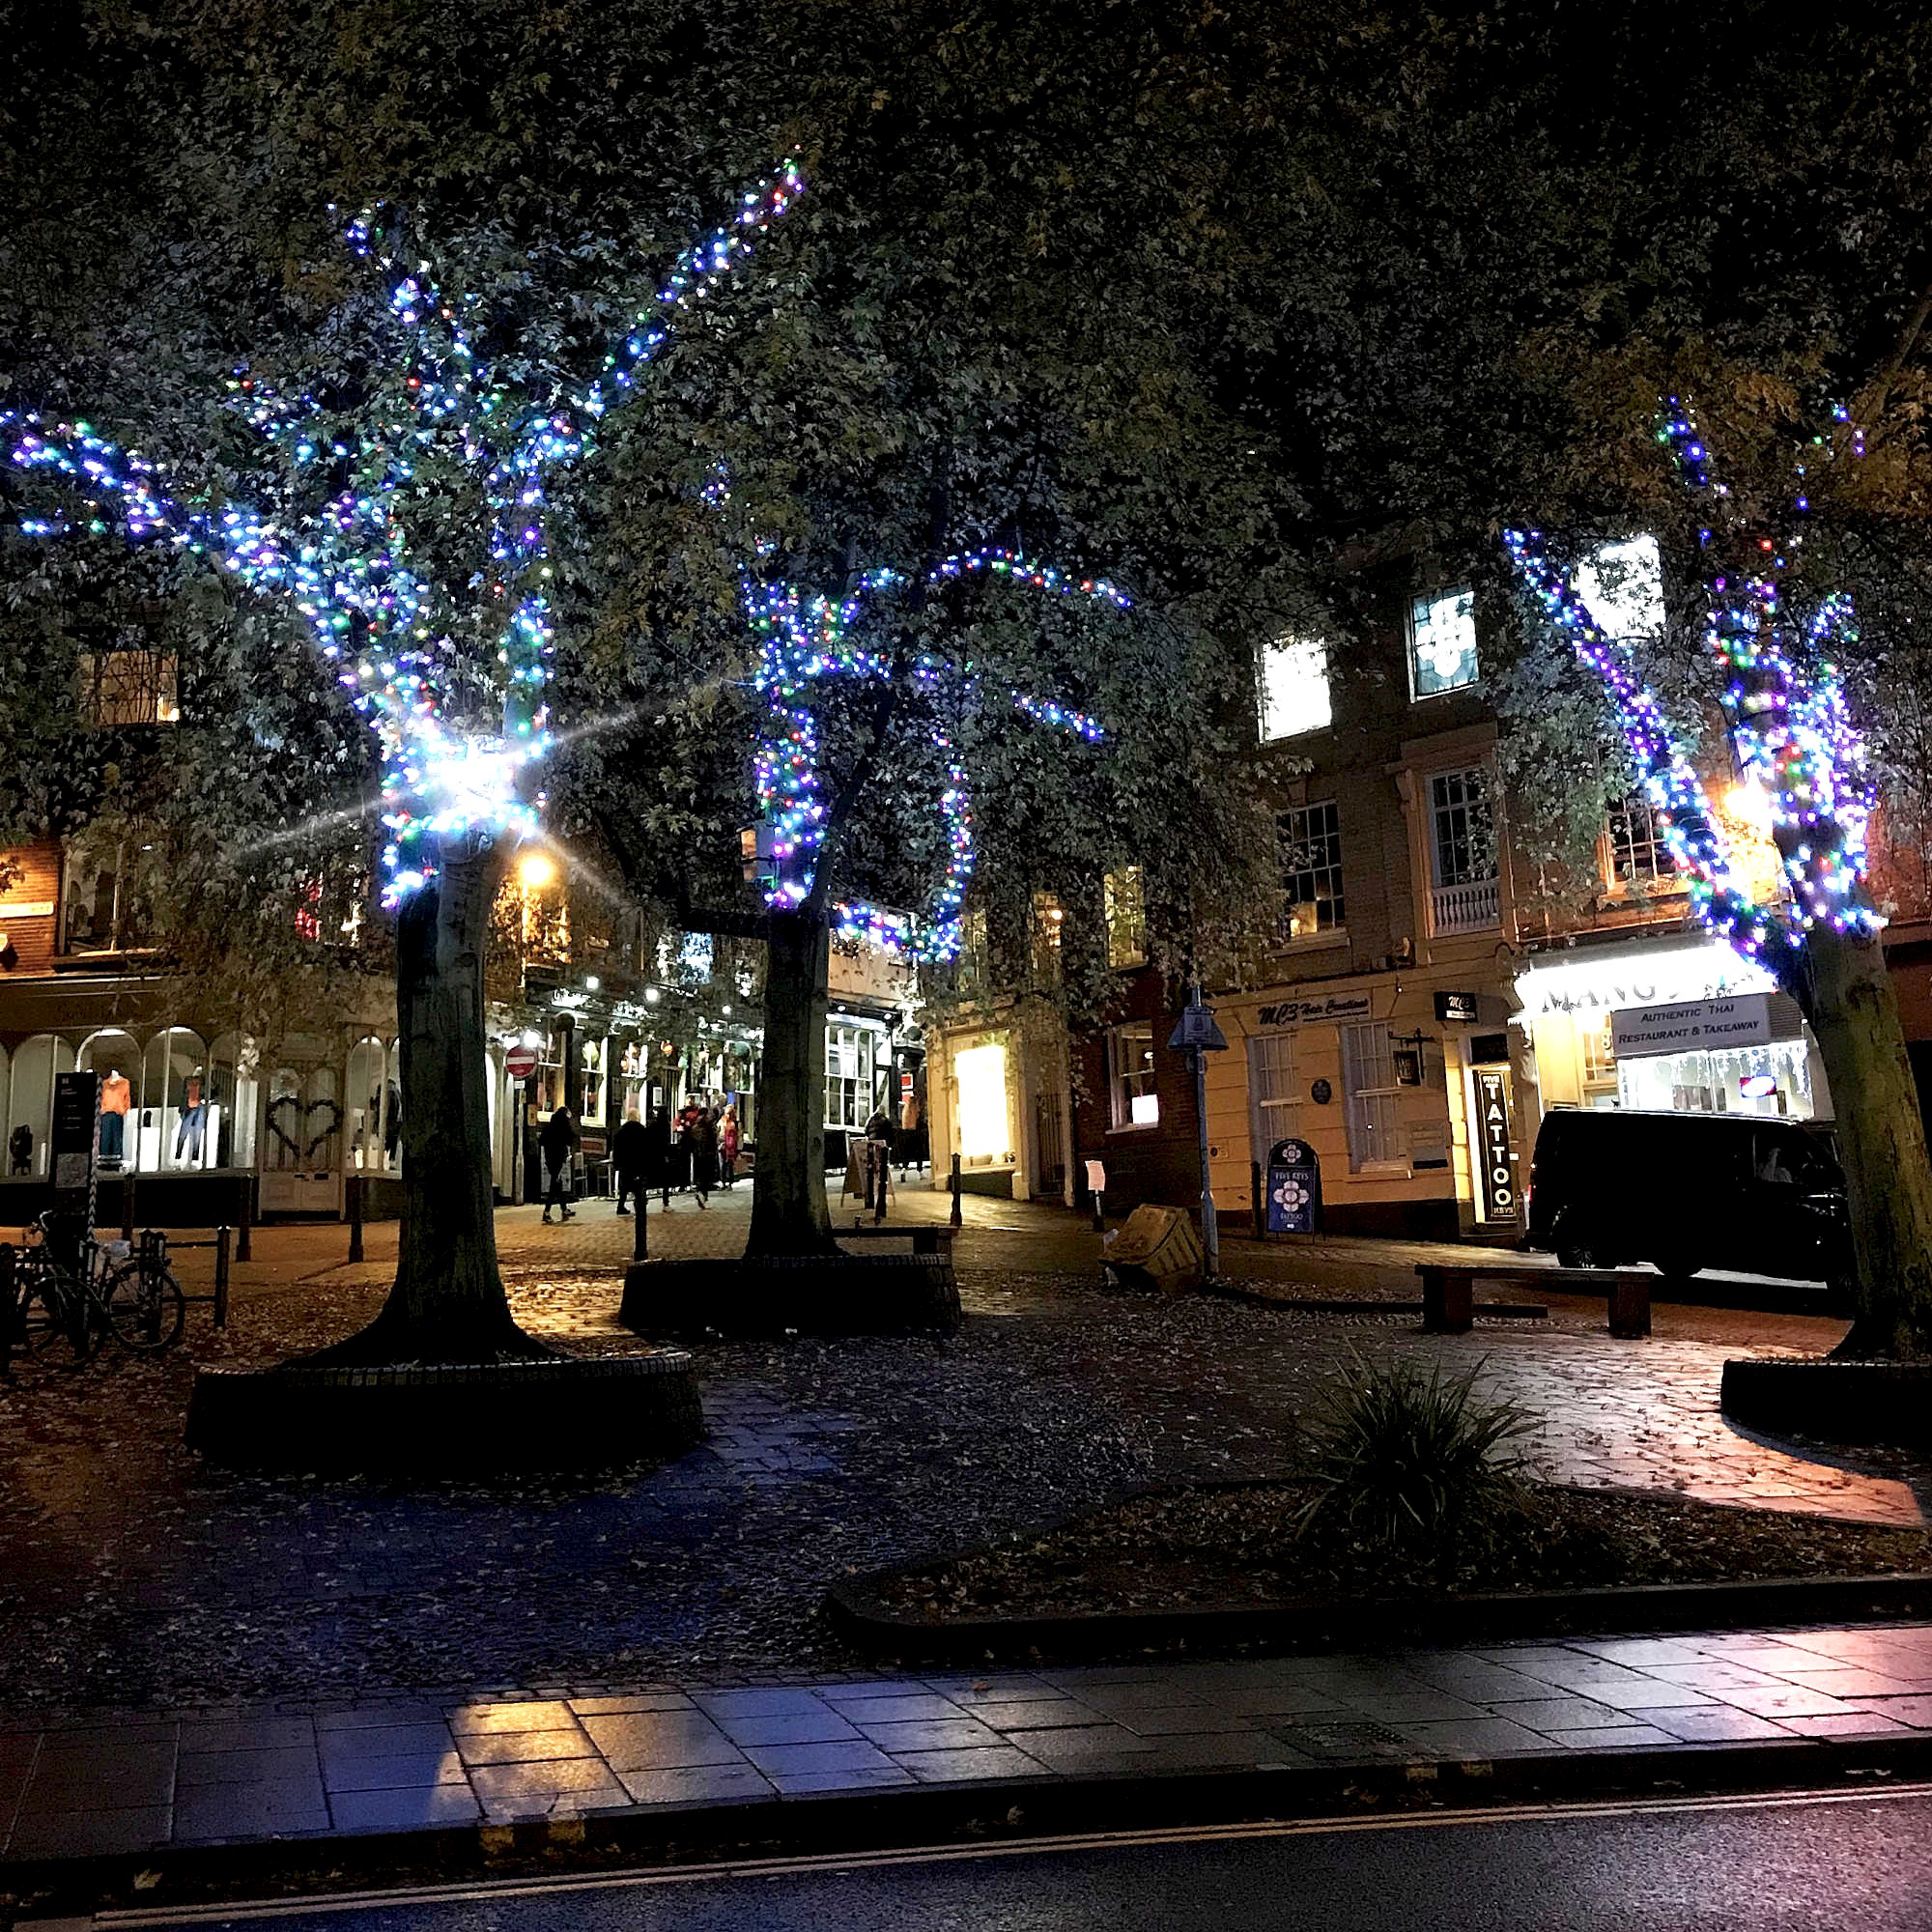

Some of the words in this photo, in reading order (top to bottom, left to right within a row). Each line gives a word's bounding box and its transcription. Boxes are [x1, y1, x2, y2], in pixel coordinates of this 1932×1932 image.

[1448, 995, 1470, 1010] MC3
[1641, 1009, 1702, 1023] AUTHENTIC
[1708, 1004, 1735, 1015] THAI
[1258, 1003, 1298, 1026] MC3
[1618, 1028, 1689, 1044] RESTAURANT
[1691, 1027, 1700, 1036] &
[1704, 1020, 1759, 1035] TAKEAWAY
[1486, 1083, 1512, 1206] TATTOO
